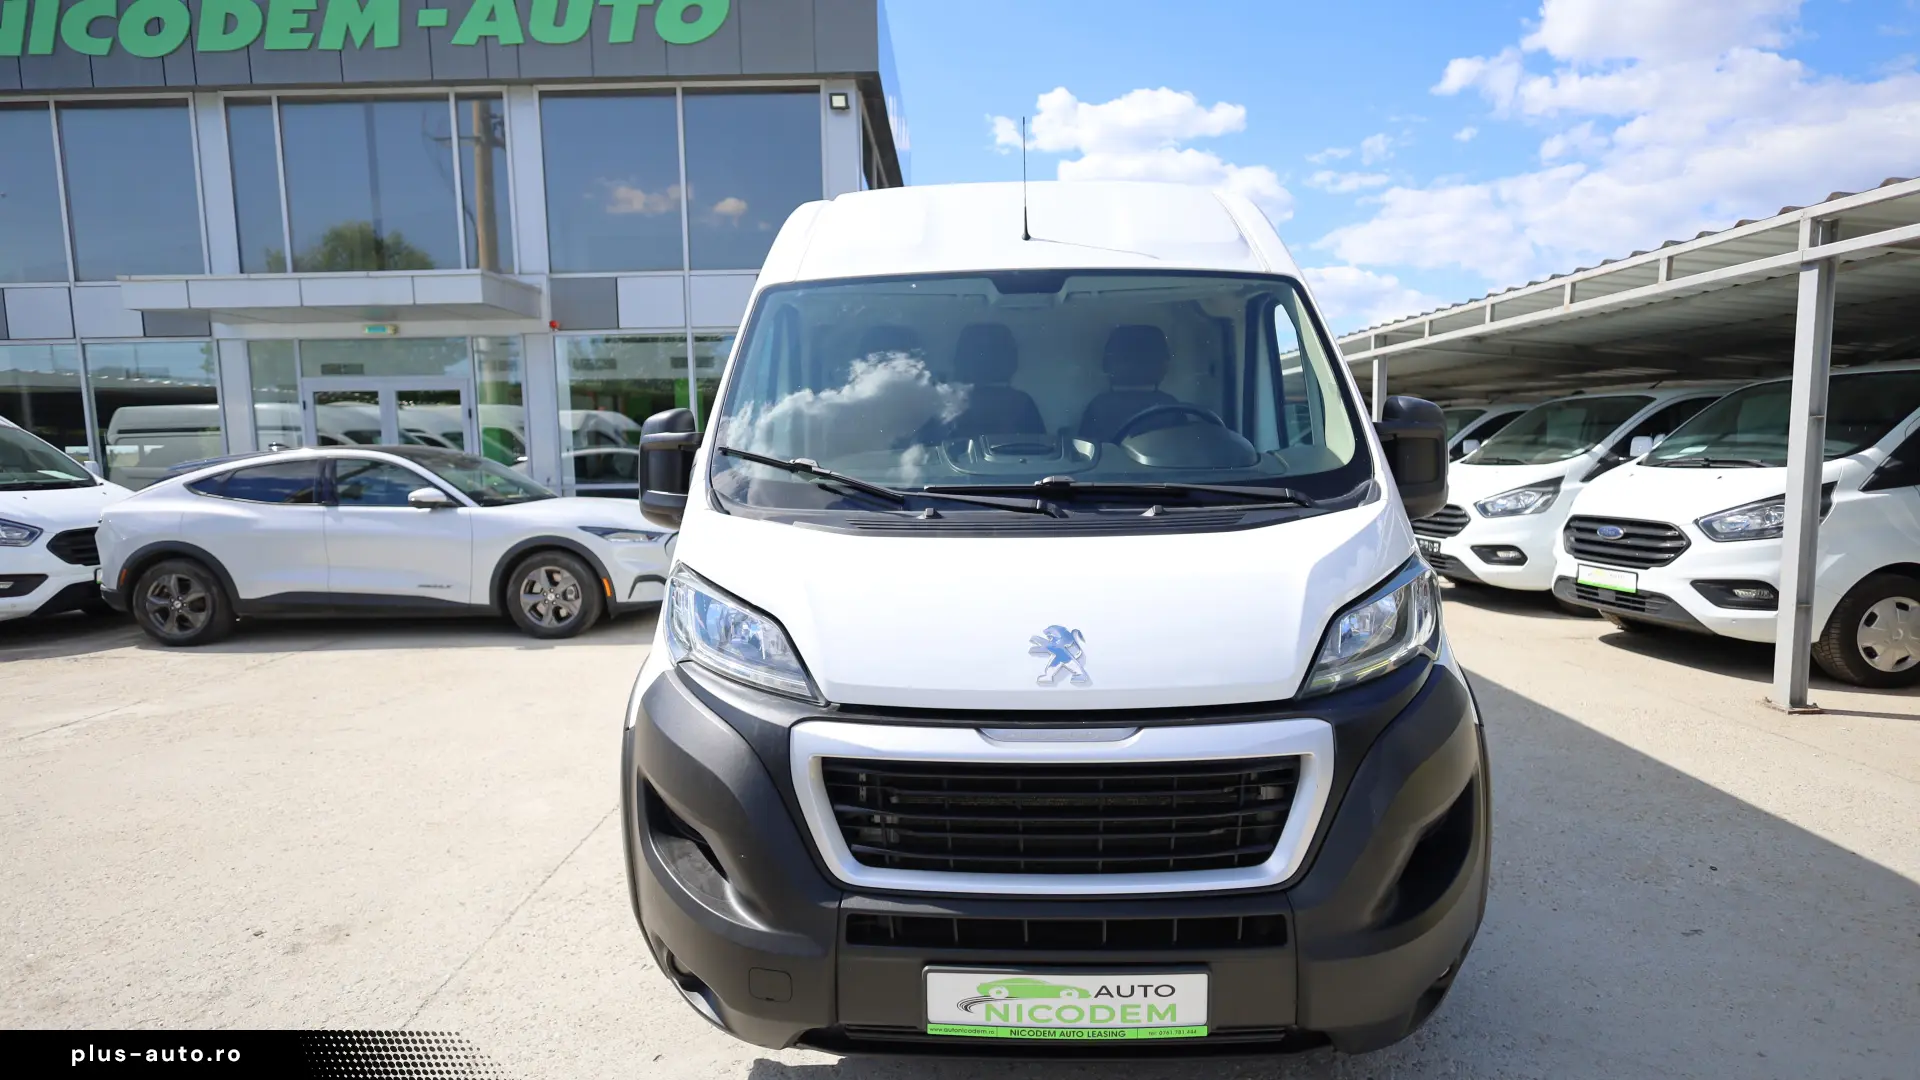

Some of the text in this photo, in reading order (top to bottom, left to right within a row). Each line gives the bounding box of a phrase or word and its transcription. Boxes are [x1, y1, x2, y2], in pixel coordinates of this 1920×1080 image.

[1093, 984, 1176, 998] AUTO
[985, 1003, 1177, 1024] NICODEM
[929, 1027, 995, 1035] www.autonicodem.ro
[1009, 1029, 1126, 1038] NICODEM AUTO LEASING
